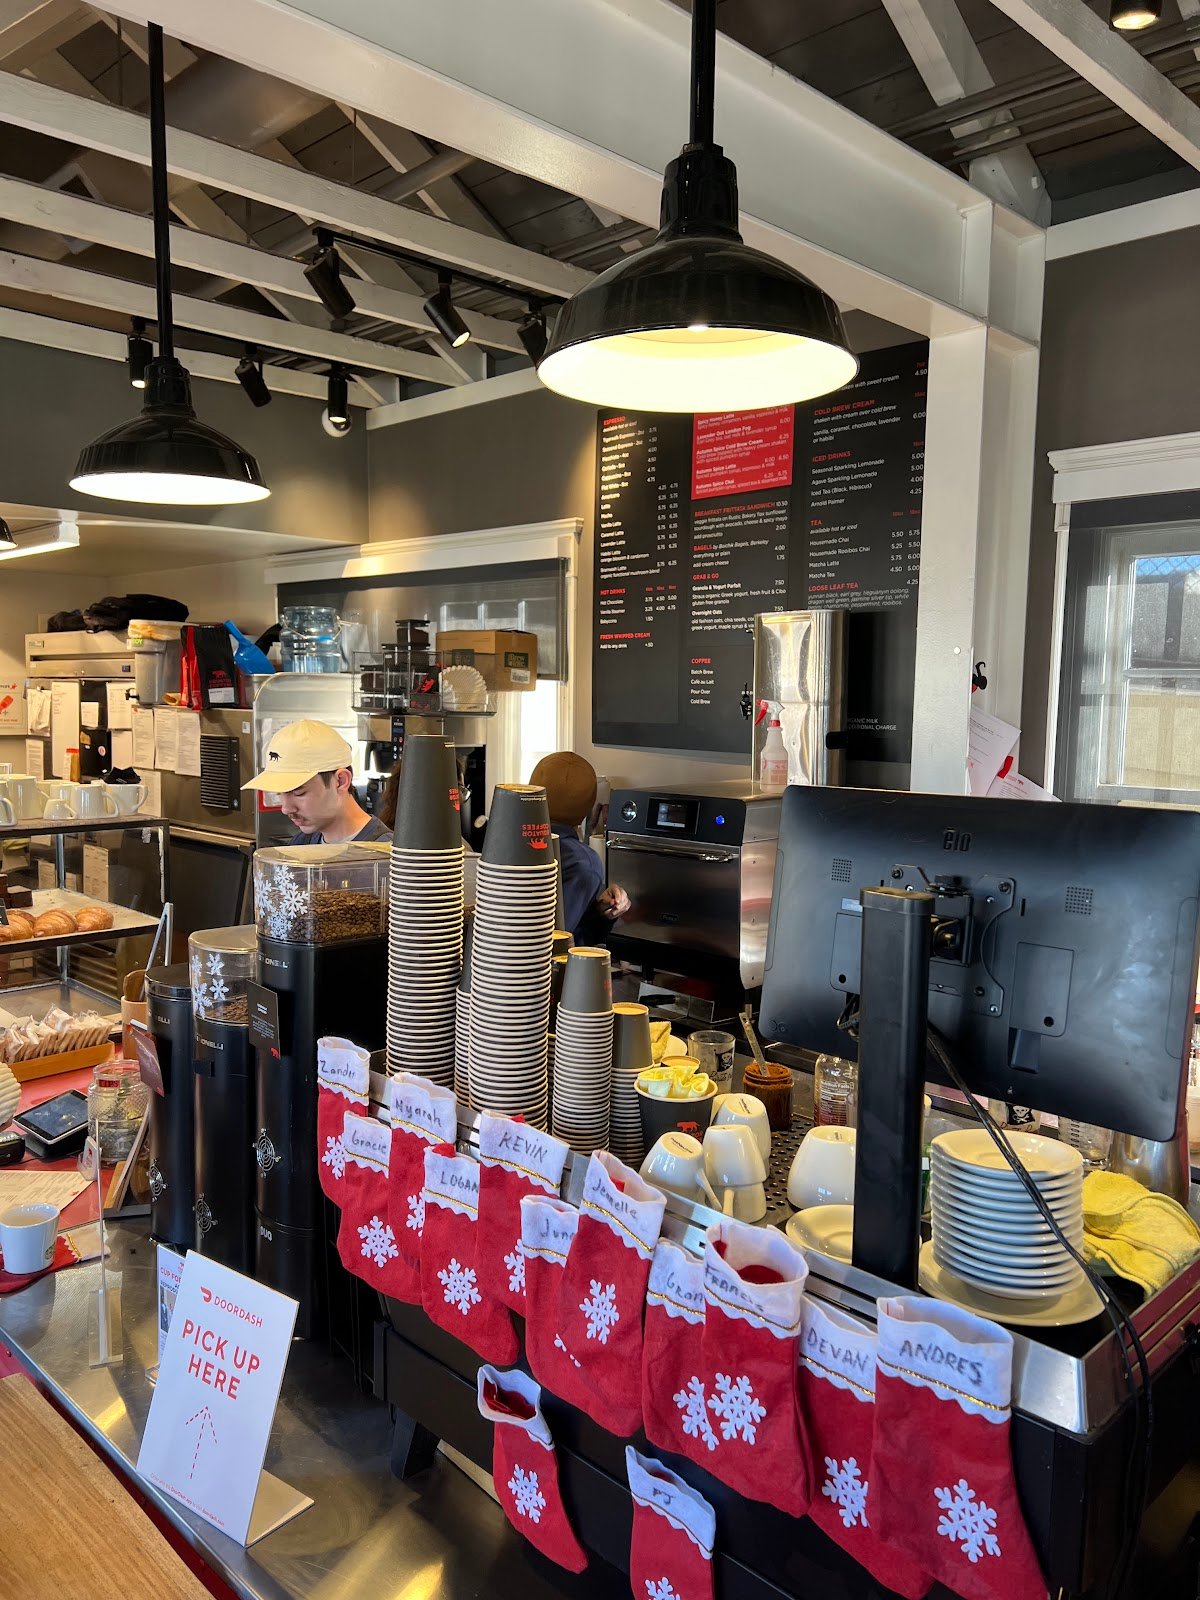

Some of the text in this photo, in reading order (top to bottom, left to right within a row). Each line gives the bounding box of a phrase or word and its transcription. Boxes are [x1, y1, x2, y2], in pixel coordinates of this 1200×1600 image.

[815, 400, 875, 416] COLD BREW CREAM
[813, 451, 851, 463] ICED DRINKS
[834, 463, 857, 471] Sparkling
[858, 459, 885, 468] Lemonade
[828, 475, 850, 484] Sparkling
[851, 471, 878, 480] Lemonade
[695, 509, 722, 517] BREAKFAST
[747, 502, 775, 510] SANDWICH
[810, 538, 837, 546] Housemade
[160, 1267, 171, 1278] CUP
[214, 1296, 263, 1328] DOORDASH
[182, 1319, 261, 1375] PICK UP
[807, 1327, 869, 1373] DEVAN
[900, 1340, 983, 1387] ANDRES
[188, 1354, 241, 1400] HERE
